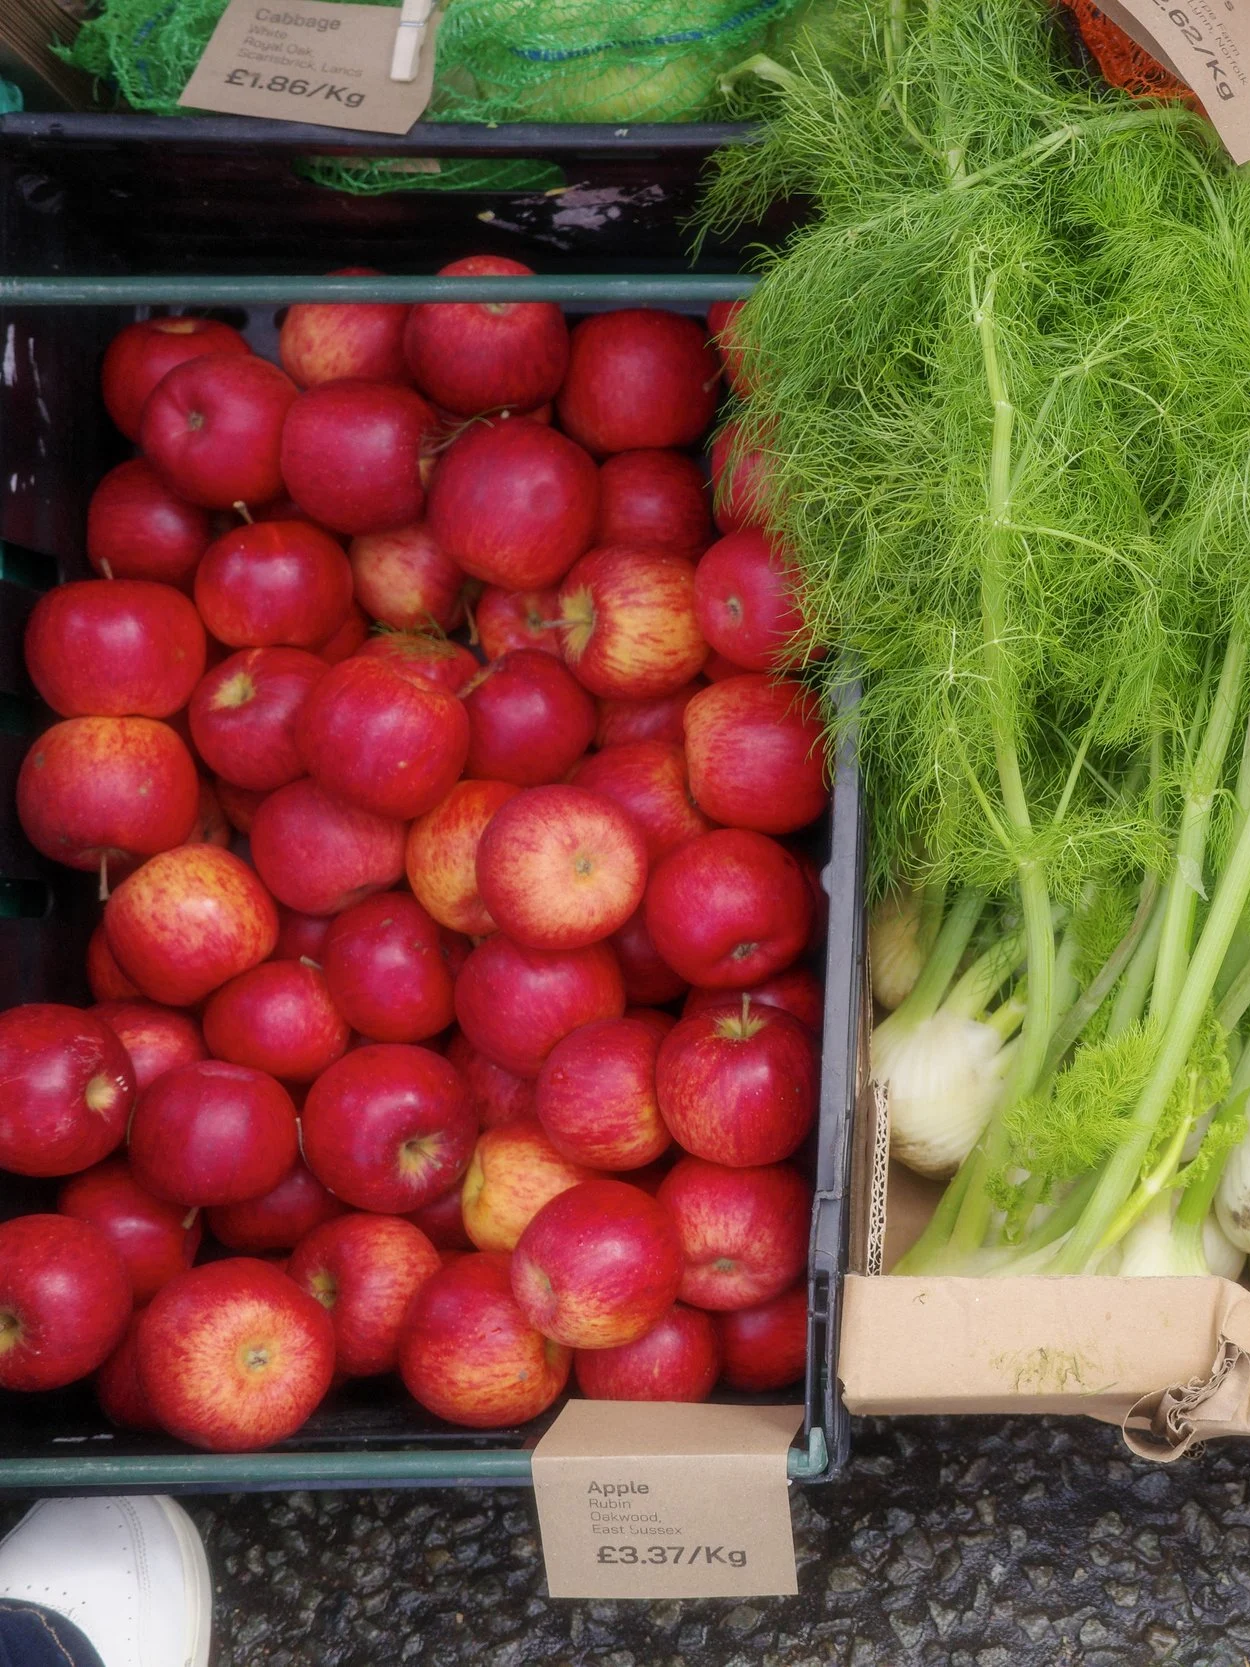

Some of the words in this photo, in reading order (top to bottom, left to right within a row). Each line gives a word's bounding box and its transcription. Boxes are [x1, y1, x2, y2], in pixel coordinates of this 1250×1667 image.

[255, 8, 341, 32] Cabbage
[1217, 23, 1240, 56] Farm
[1215, 37, 1248, 85] Norfolk
[224, 69, 366, 108] £1.86/Kg
[587, 1480, 650, 1498] Apple
[588, 1498, 632, 1510] Rubin
[590, 1511, 662, 1524] Oakwood,
[591, 1524, 625, 1535] East
[629, 1525, 683, 1536] Sussex
[597, 1546, 748, 1568] £3.37/Kg
